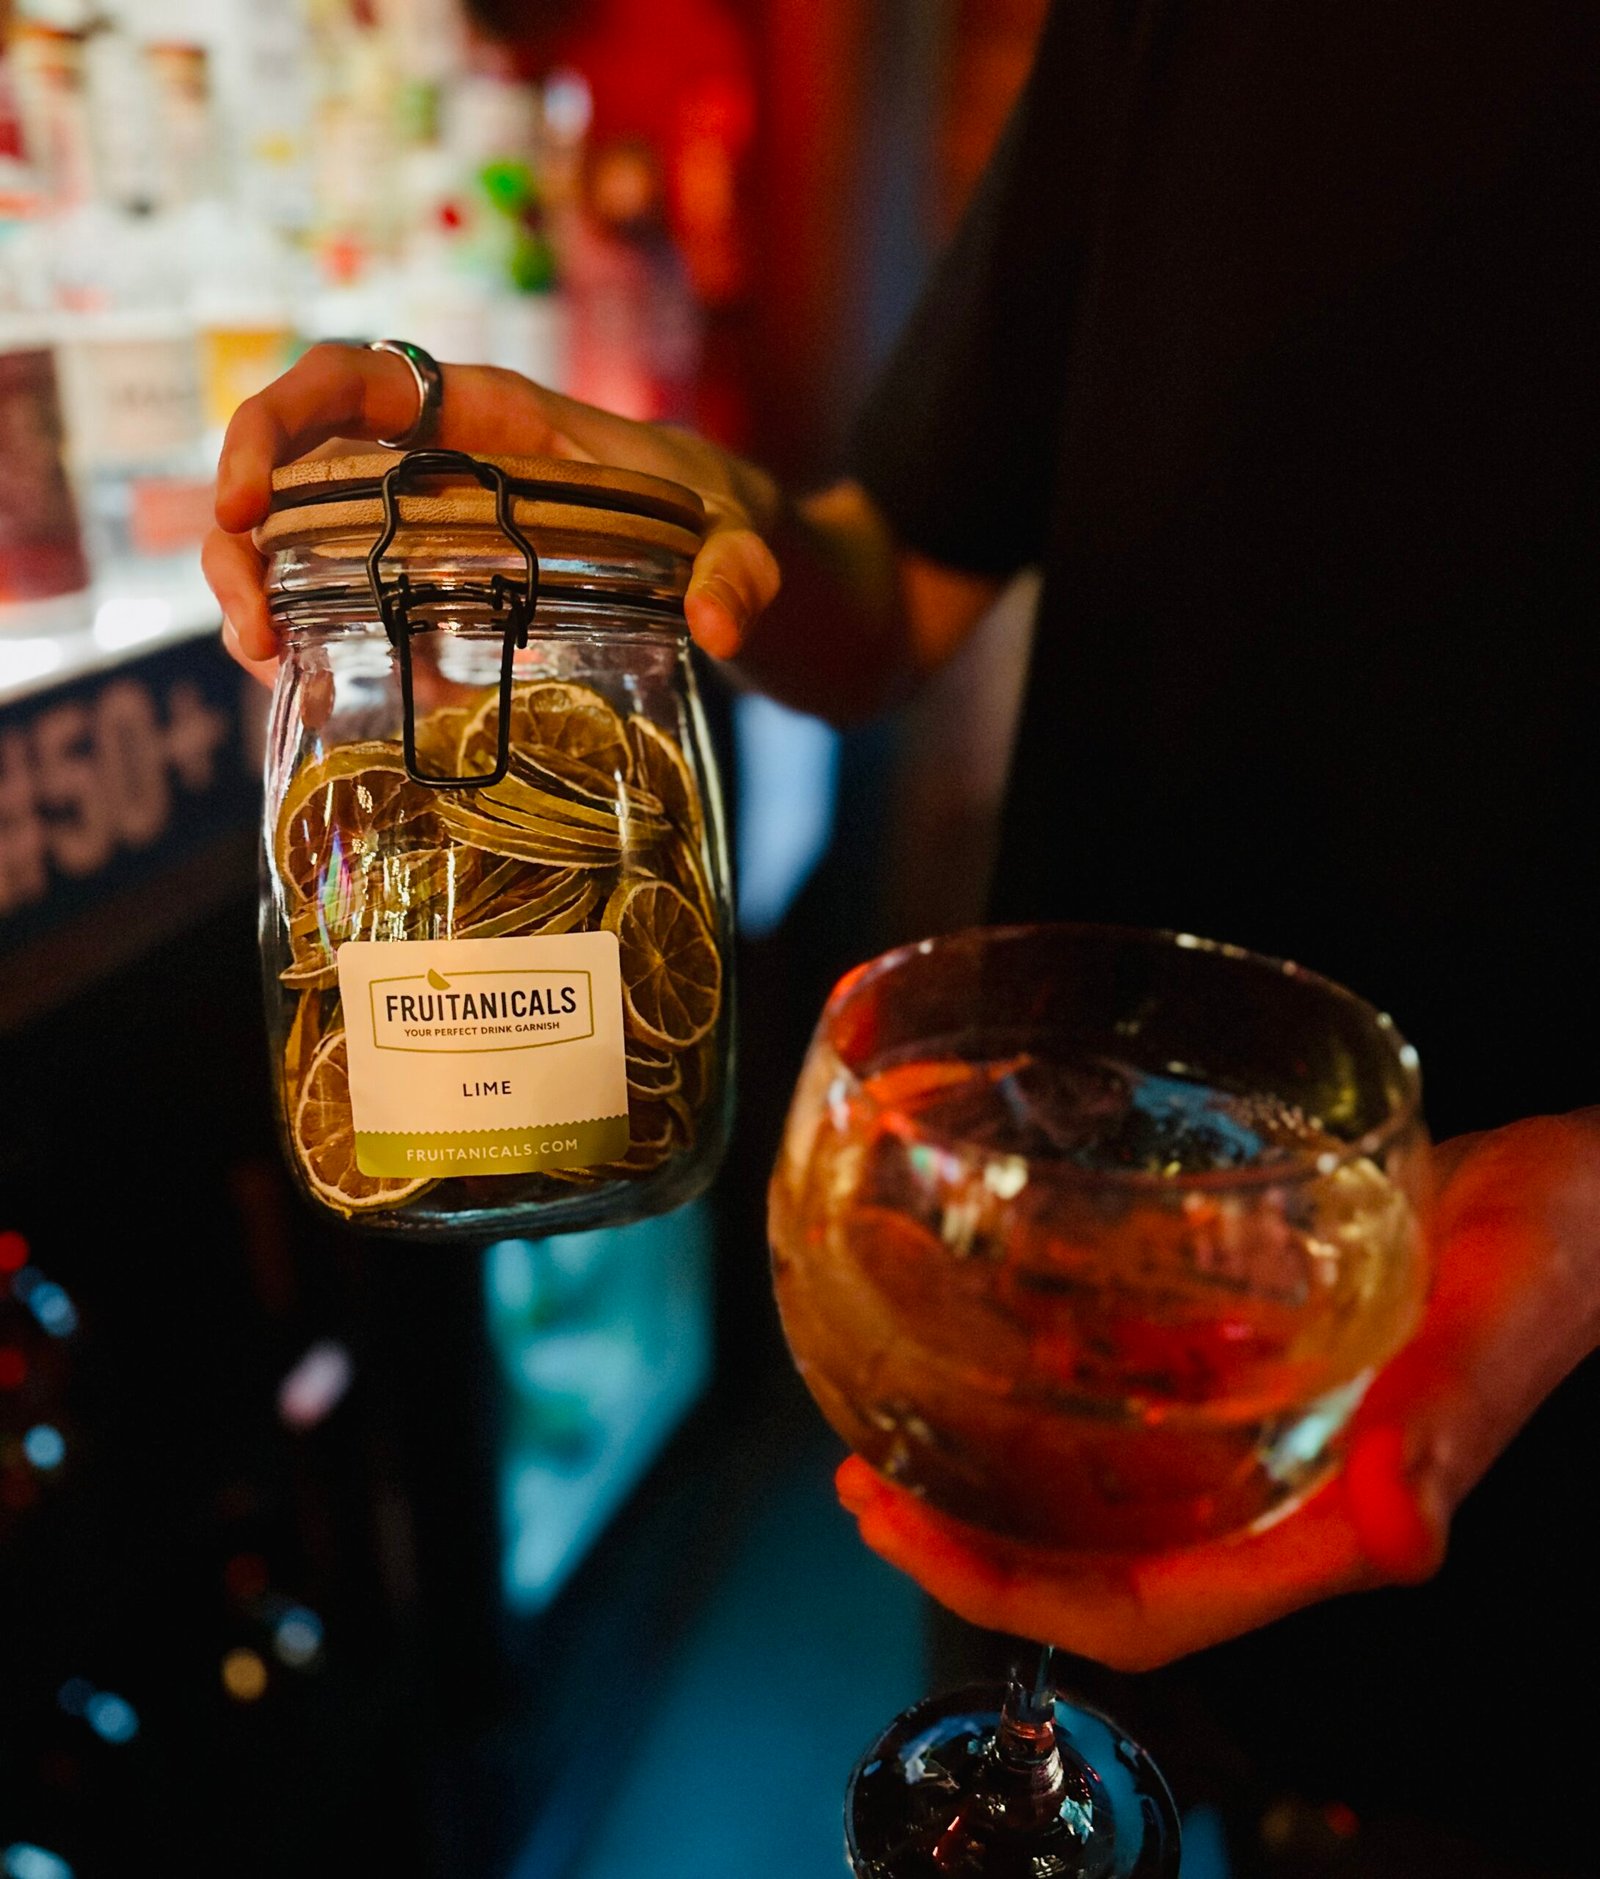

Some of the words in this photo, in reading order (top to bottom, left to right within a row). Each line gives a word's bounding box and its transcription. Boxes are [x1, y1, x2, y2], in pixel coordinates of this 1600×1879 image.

[386, 987, 577, 1022] FRUITANICALS
[404, 1028, 432, 1037] YOUR
[434, 1027, 478, 1036] PERFECT
[481, 1025, 513, 1035] DRINK
[514, 1022, 560, 1033] GARNISH
[462, 1080, 512, 1097] LIME
[406, 1139, 578, 1161] FRUITANICALS.COM
